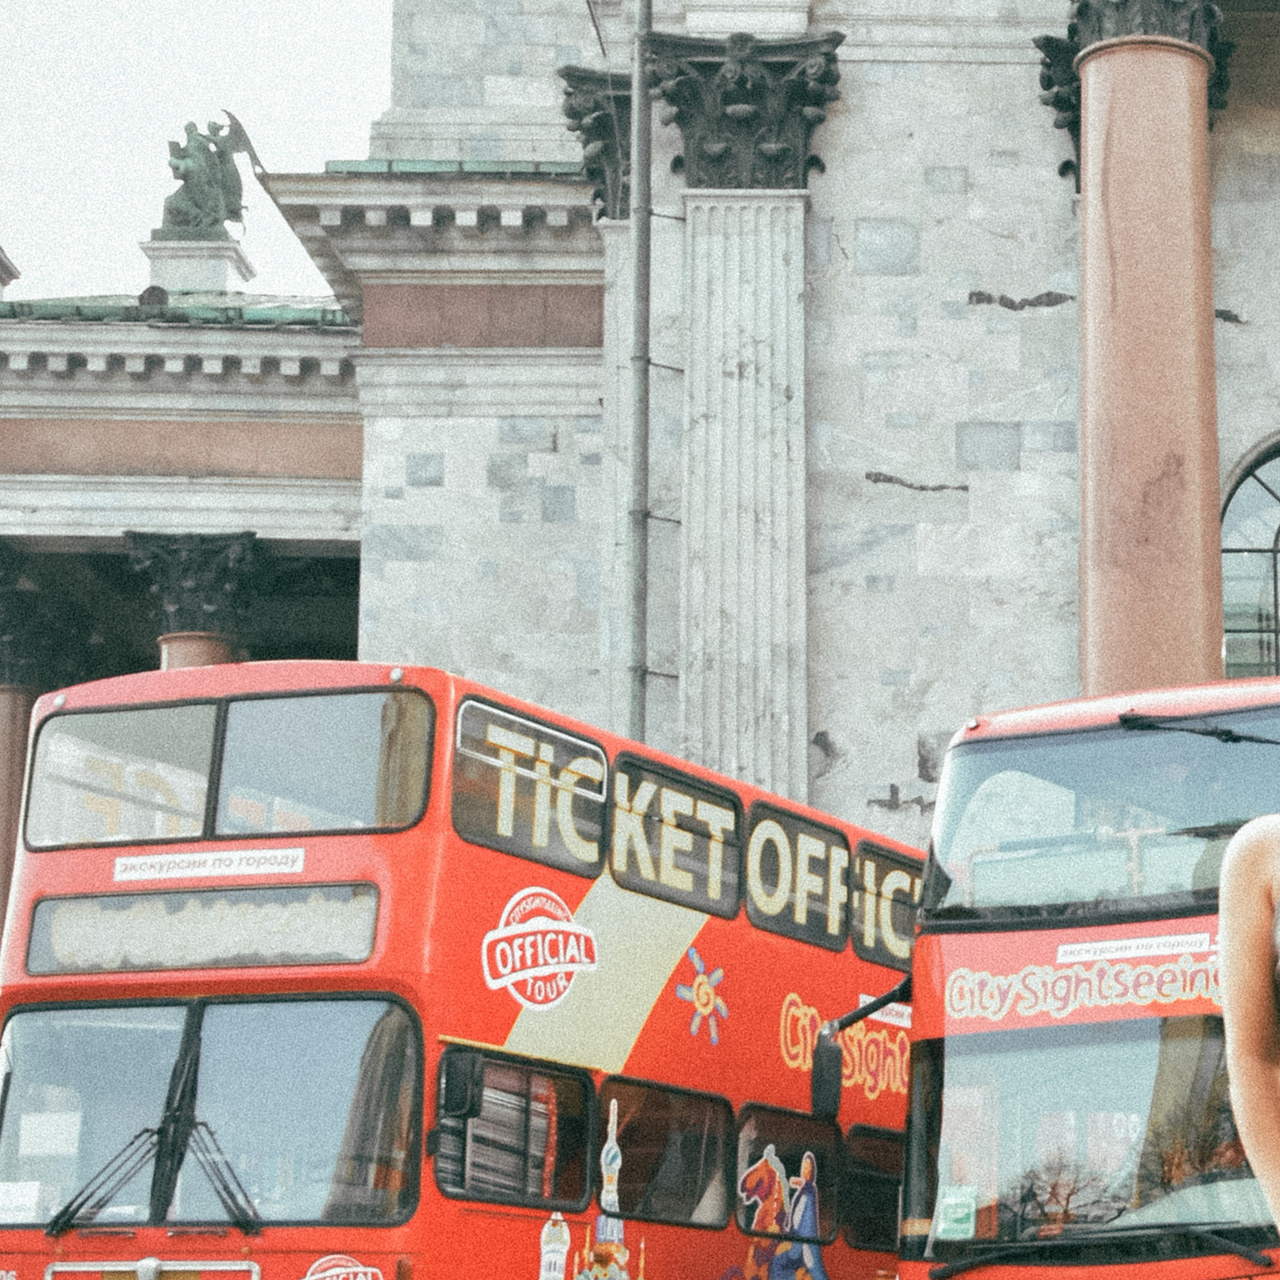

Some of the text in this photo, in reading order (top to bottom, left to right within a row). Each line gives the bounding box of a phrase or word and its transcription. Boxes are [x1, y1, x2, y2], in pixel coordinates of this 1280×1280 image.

[486, 723, 921, 960] TICKET OFFIC
[212, 856, 234, 869] по
[495, 931, 592, 975] OFFICIAL
[526, 972, 569, 1001] TOUR
